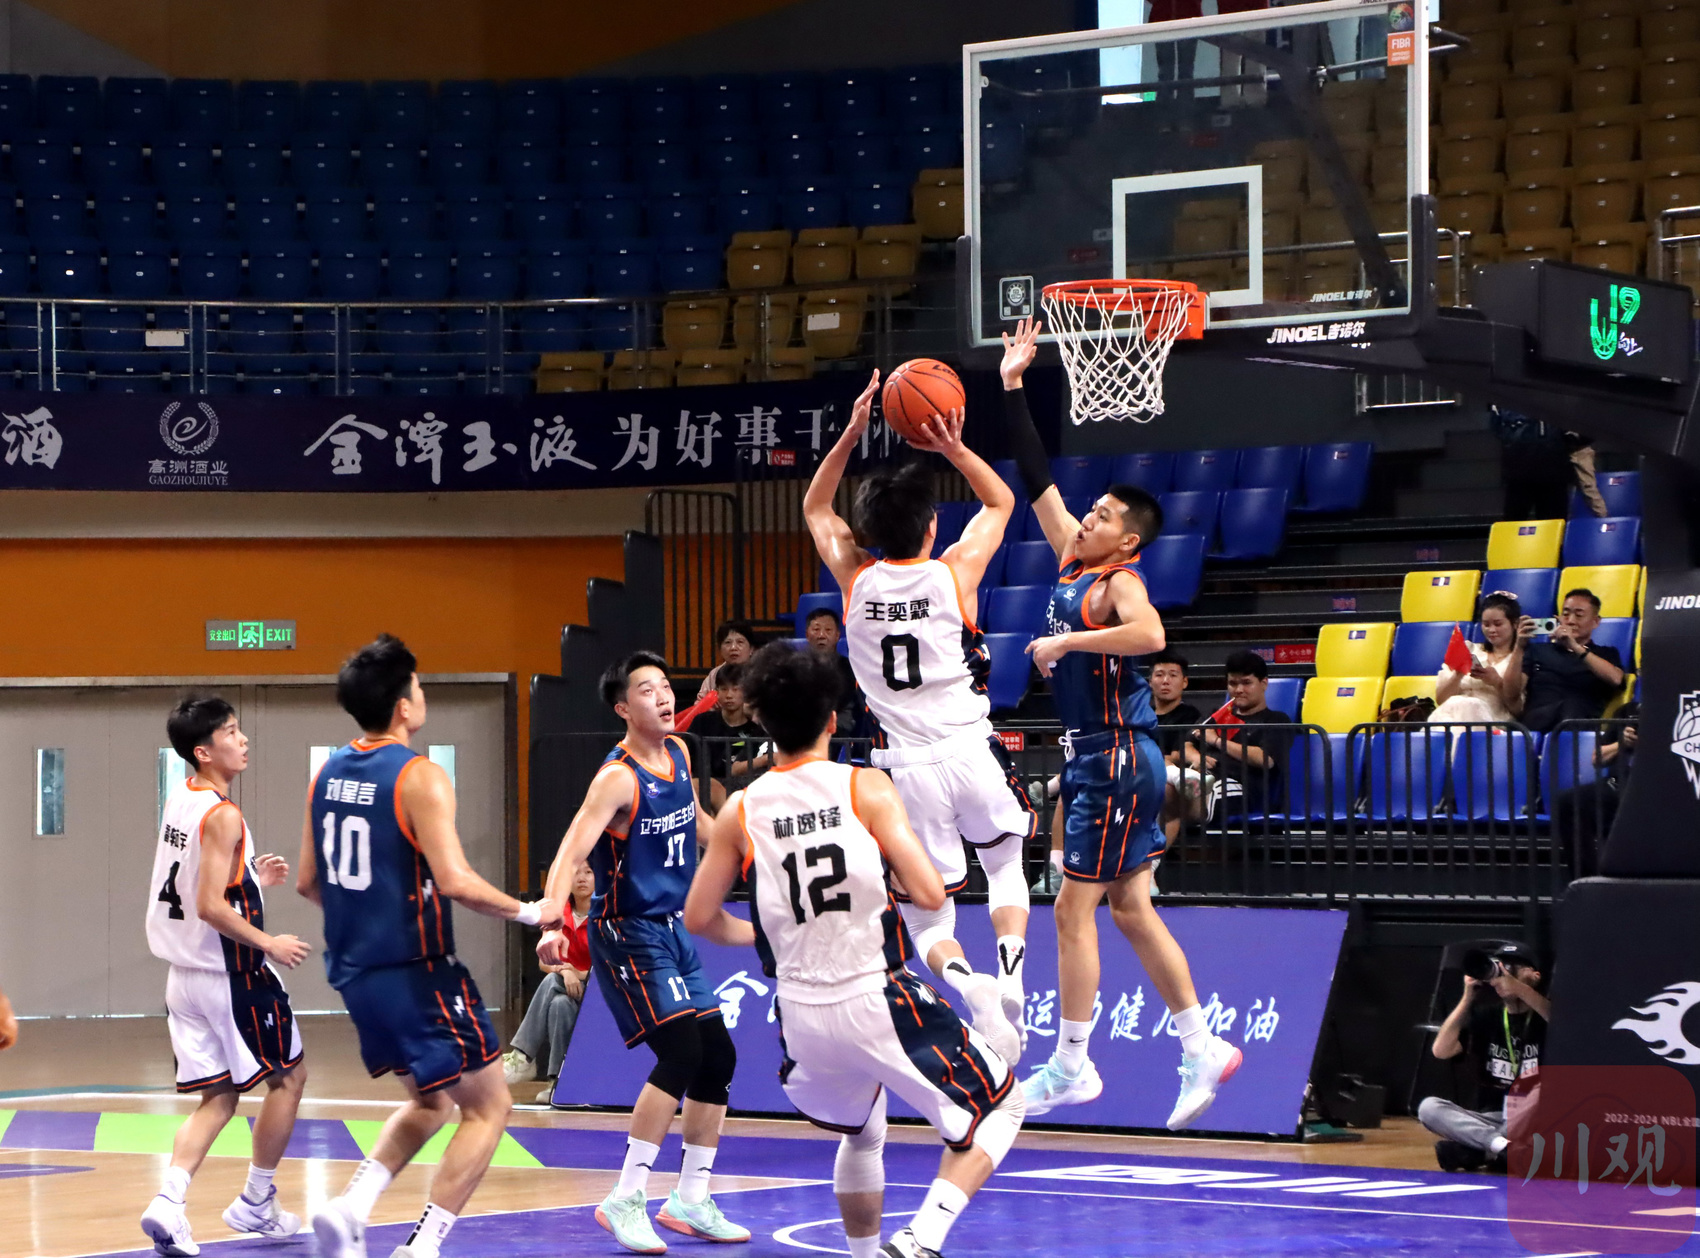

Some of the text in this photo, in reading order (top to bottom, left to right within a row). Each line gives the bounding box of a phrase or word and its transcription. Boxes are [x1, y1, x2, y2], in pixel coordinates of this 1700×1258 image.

[1391, 37, 1411, 49] FIBA
[1, 406, 64, 470] 酒
[148, 459, 229, 475] 高洲酒业
[148, 475, 229, 486] GAOZHOUJIUYE
[864, 597, 930, 622] 王奕霖
[209, 628, 292, 641] 安全出口 EXIT
[880, 633, 923, 692] 0
[772, 805, 842, 840] 林逸锋
[322, 811, 372, 891] 10
[663, 832, 686, 867] 17
[158, 860, 184, 920] 4
[782, 842, 852, 926] 12
[668, 976, 691, 1002] 17
[1604, 1112, 1658, 1125] 2022-2024
